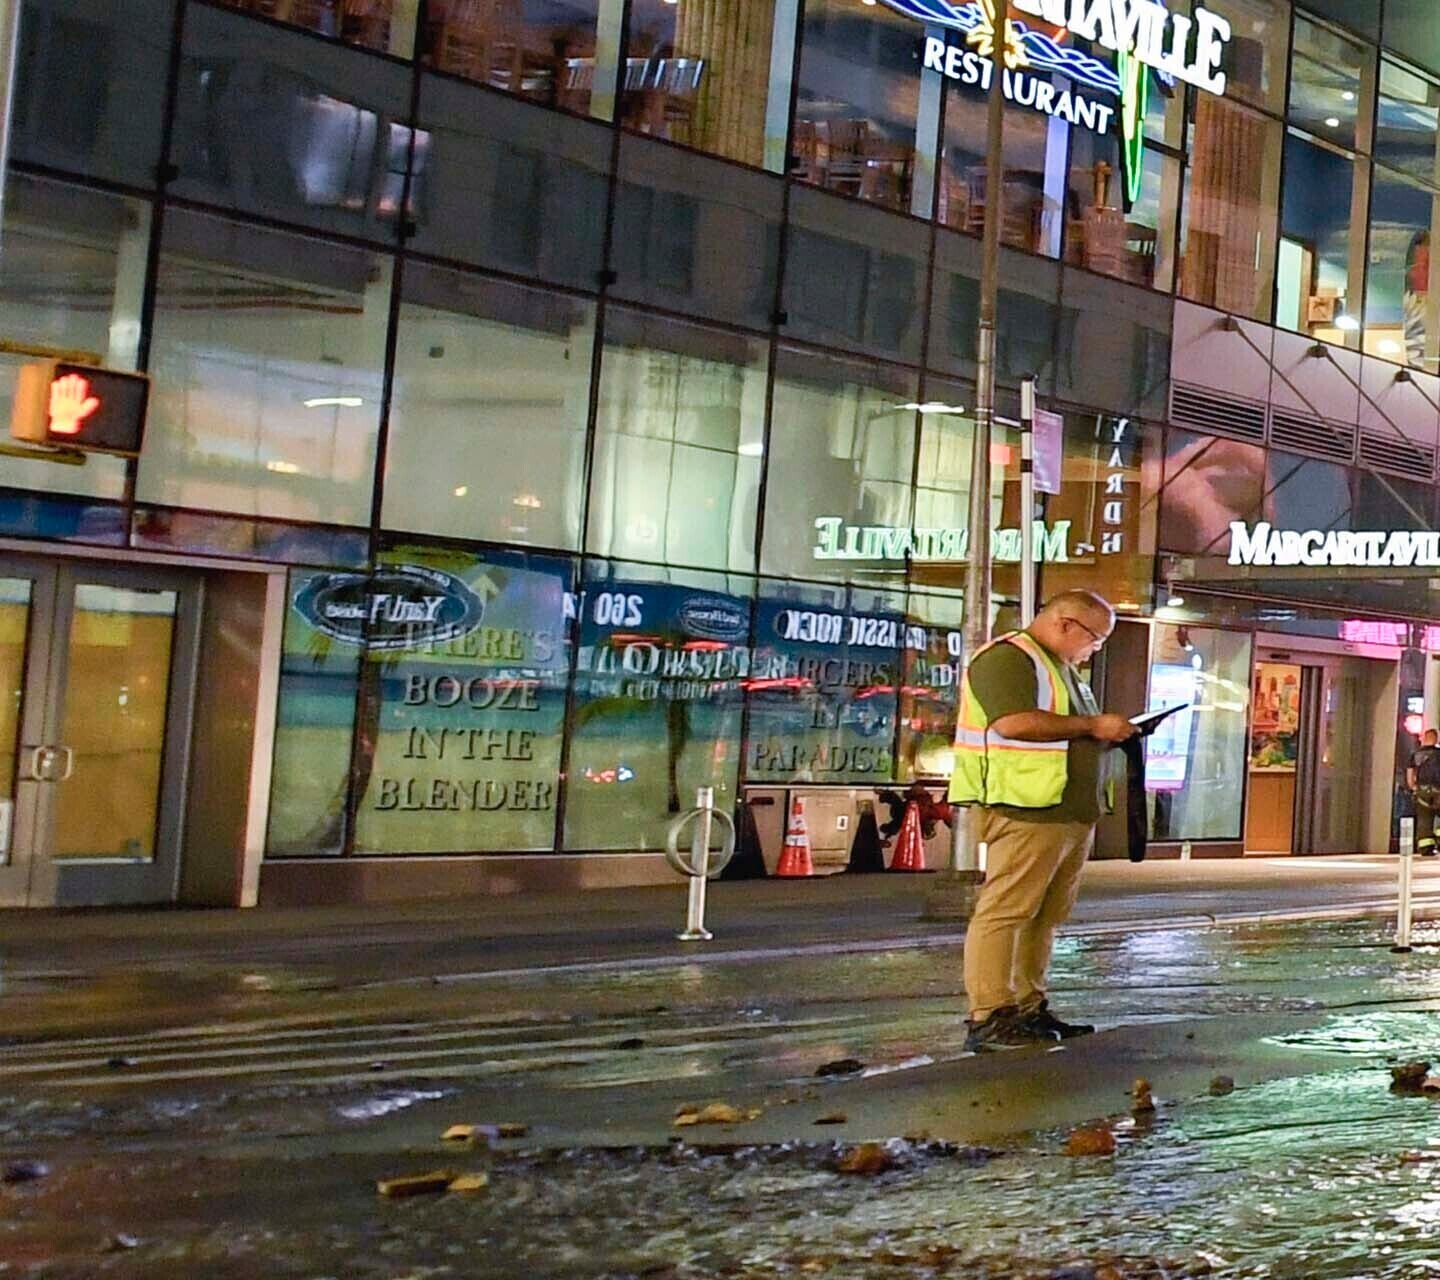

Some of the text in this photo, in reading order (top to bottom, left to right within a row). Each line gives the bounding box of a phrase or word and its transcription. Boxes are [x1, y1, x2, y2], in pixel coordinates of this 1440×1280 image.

[924, 37, 1115, 135] RESTAURANT
[404, 671, 542, 711] BOOZE
[402, 726, 537, 761] IN THE
[754, 744, 890, 773] PARADISE
[374, 778, 551, 812] BLENDER
